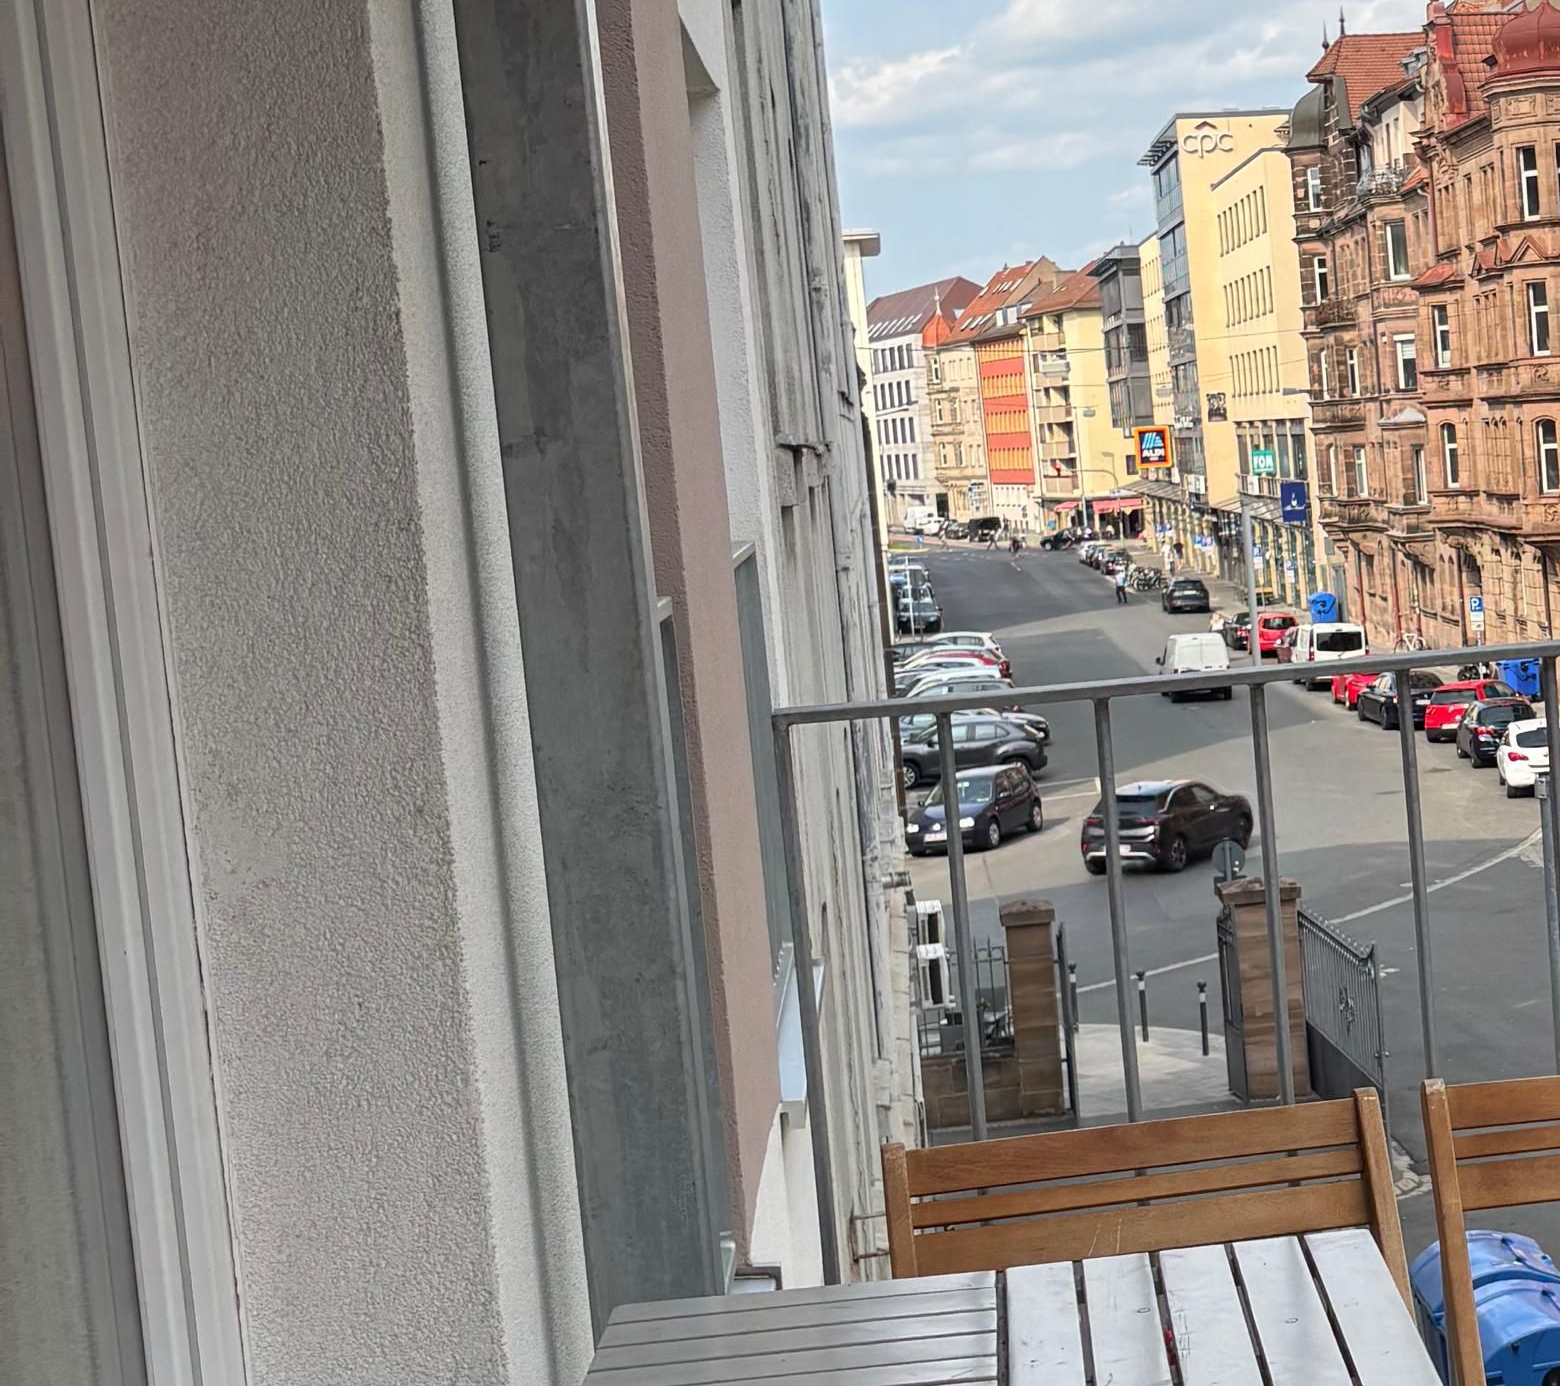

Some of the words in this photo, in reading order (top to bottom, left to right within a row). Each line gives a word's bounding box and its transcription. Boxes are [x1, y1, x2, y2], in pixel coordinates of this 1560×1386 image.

[1182, 133, 1234, 159] cpc
[1142, 448, 1166, 458] ALDI
[1471, 598, 1480, 611] P
